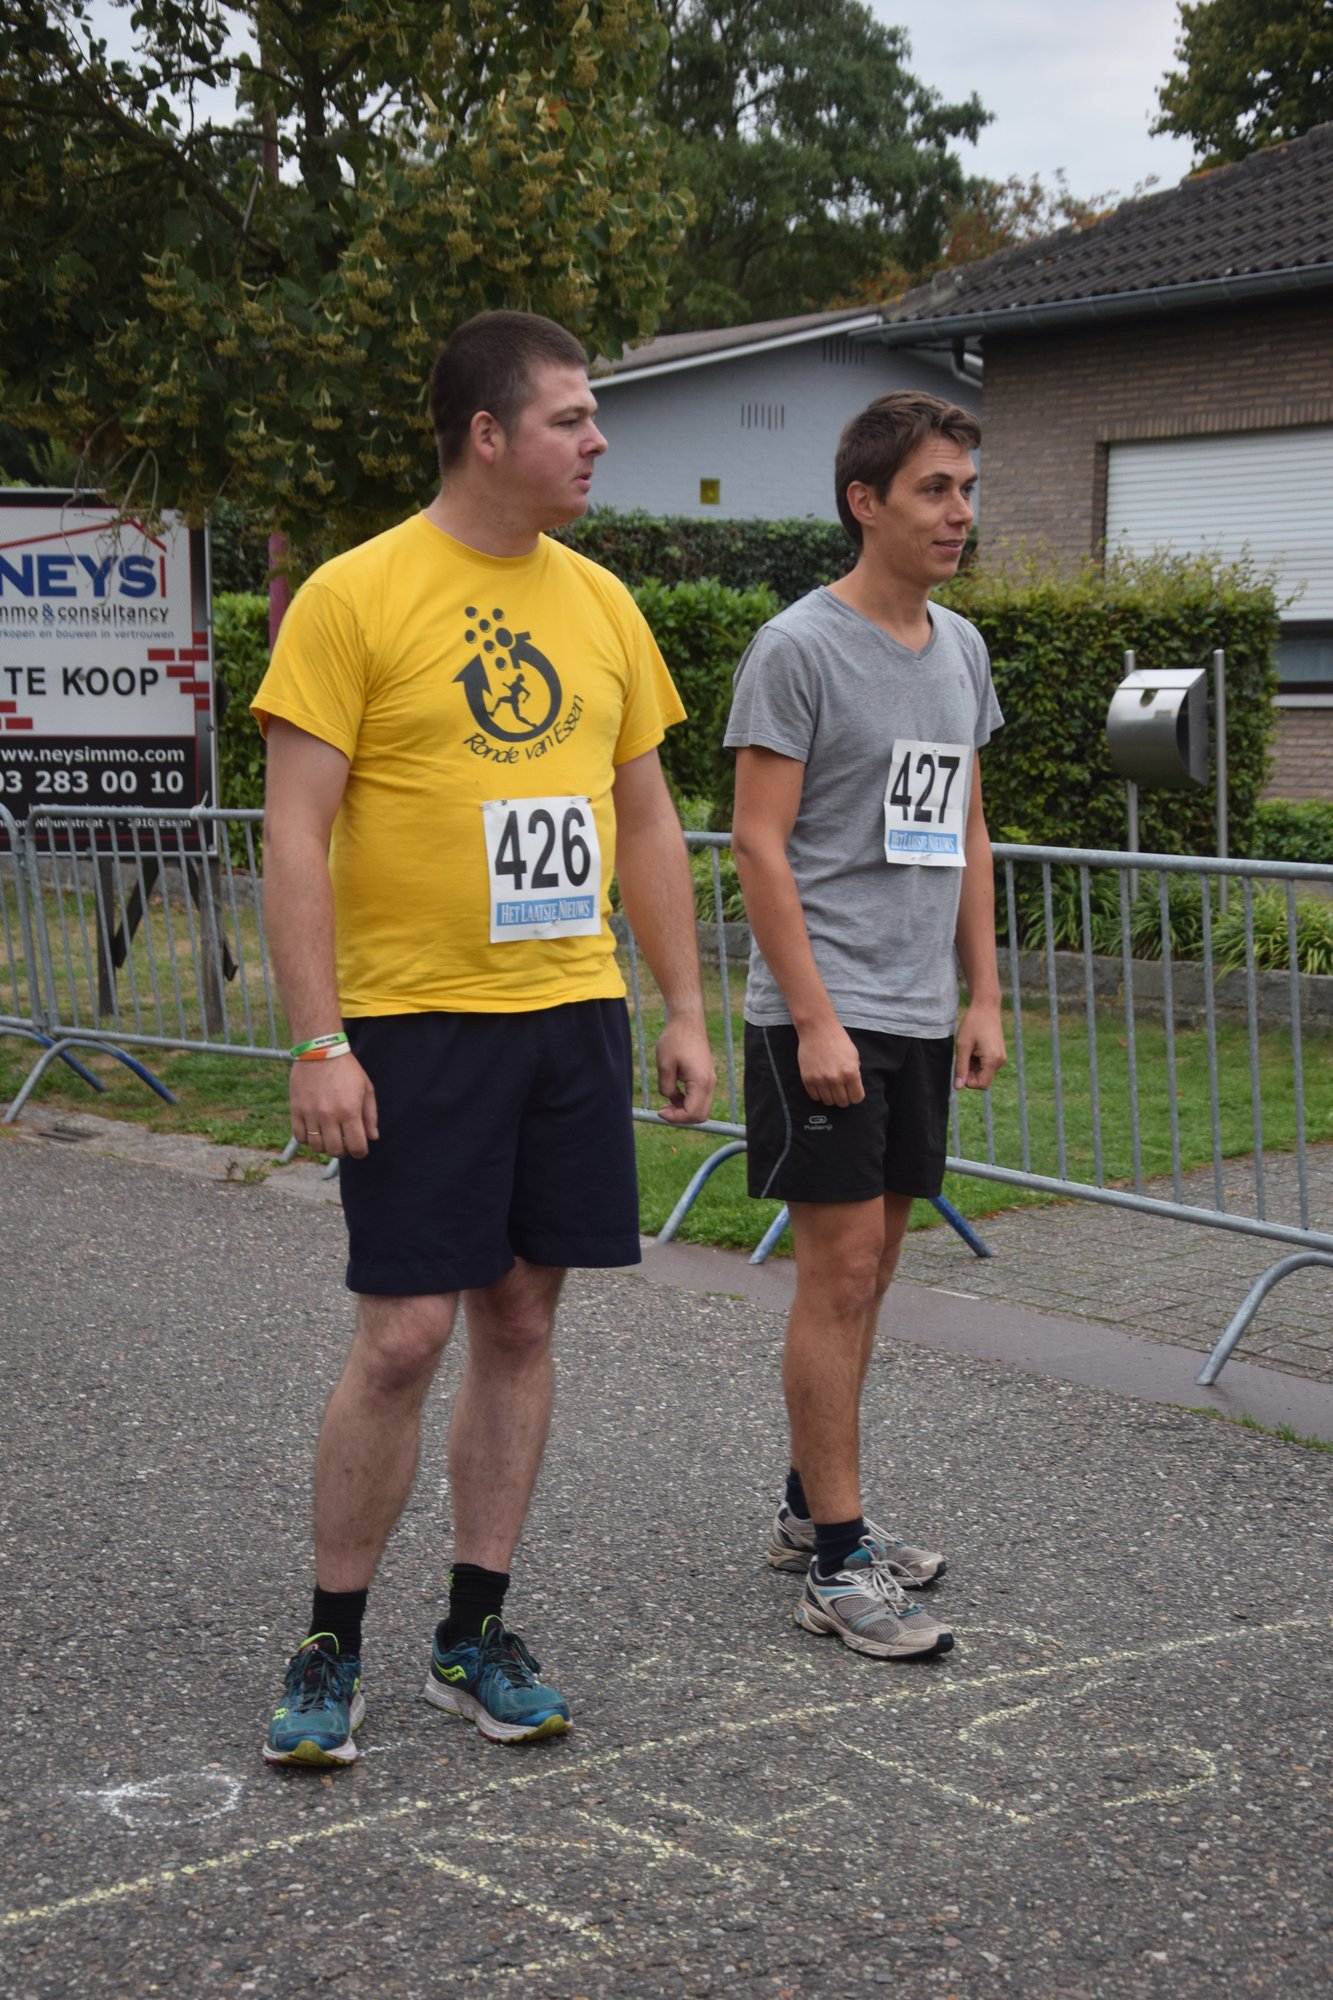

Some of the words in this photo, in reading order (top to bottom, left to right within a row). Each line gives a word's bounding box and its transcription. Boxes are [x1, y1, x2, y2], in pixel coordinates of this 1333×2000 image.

[0, 553, 157, 598] NEYS
[57, 603, 169, 622] consultancy
[39, 630, 52, 639] en
[56, 629, 97, 639] bouwen
[101, 629, 110, 638] in
[114, 630, 175, 640] vertrouwen
[4, 667, 46, 695] TE
[62, 667, 159, 696] KOOP
[463, 733, 519, 764] Ronde
[525, 735, 554, 760] van
[553, 694, 584, 744] Essen
[0, 770, 23, 794] 3
[35, 770, 89, 794] 283
[100, 770, 138, 794] 00
[151, 770, 184, 794] 10
[889, 751, 960, 824] 427
[495, 806, 591, 890] 426
